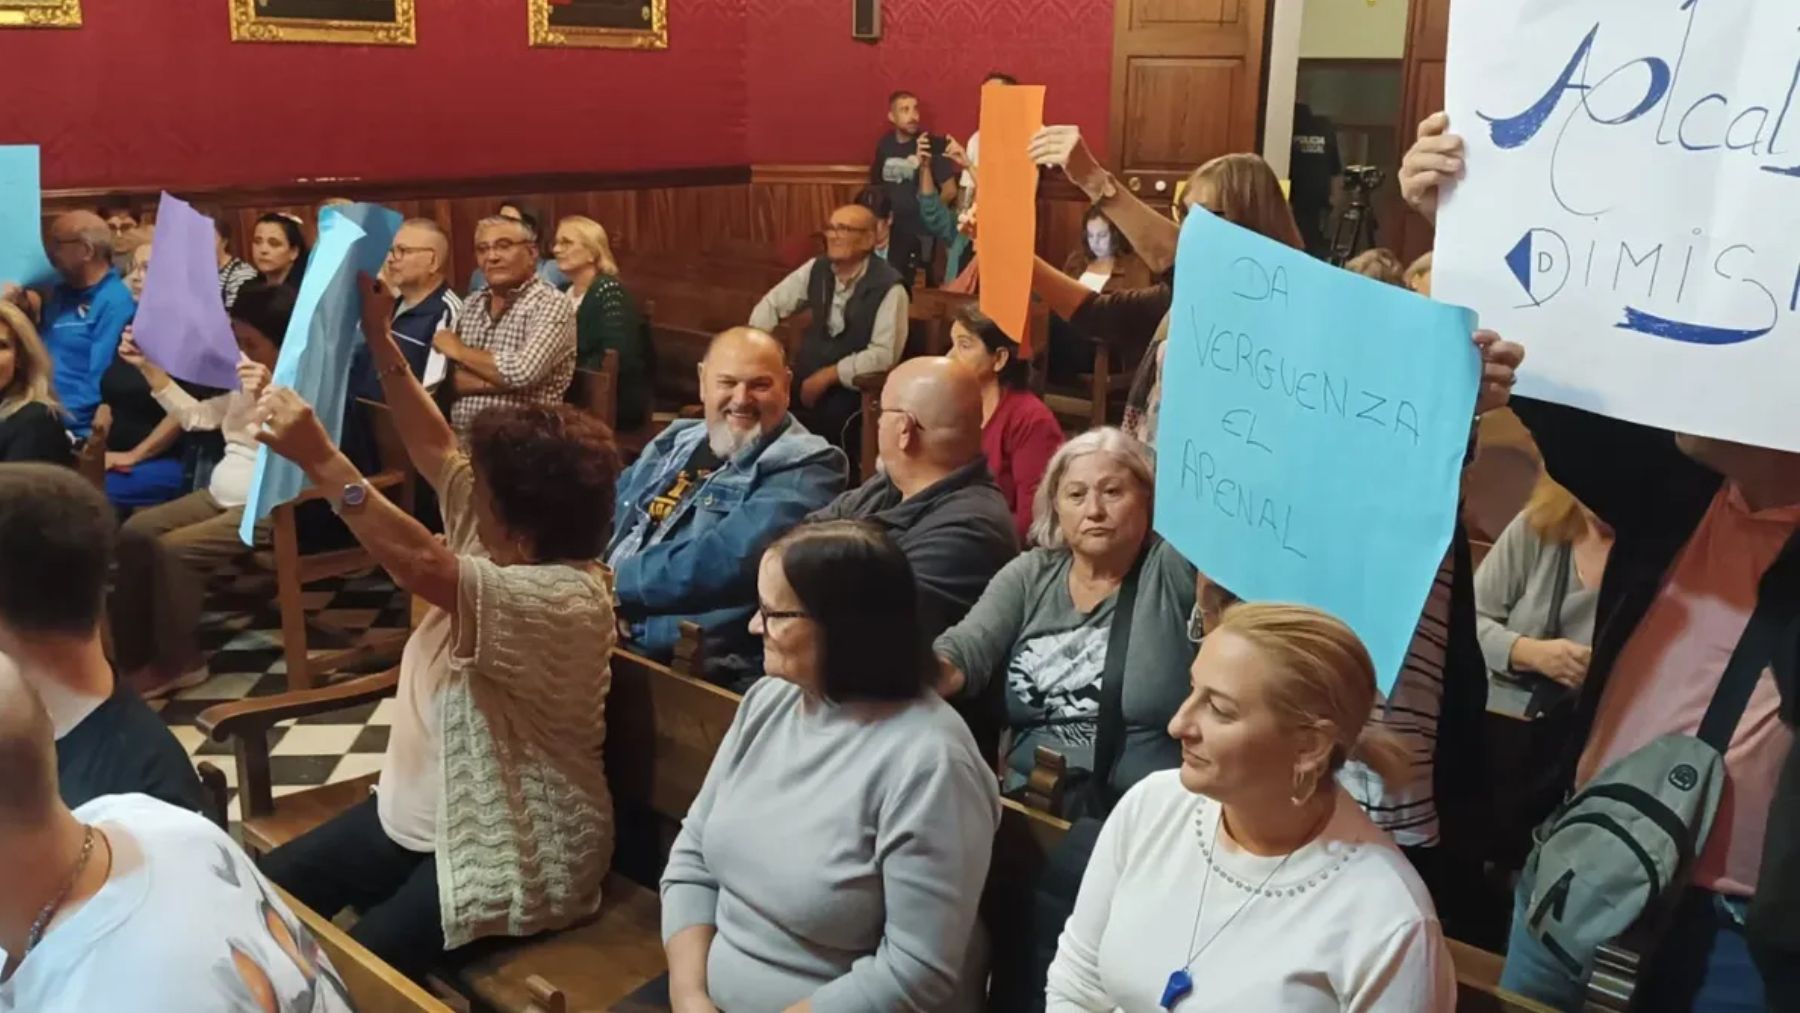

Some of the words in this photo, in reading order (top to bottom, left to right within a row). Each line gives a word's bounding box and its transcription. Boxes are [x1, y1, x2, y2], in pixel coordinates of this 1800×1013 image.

[1233, 256, 1289, 307] DA
[1191, 305, 1419, 446] VERGUENZA
[1221, 408, 1273, 454] EL
[1181, 438, 1307, 559] ARENAL
